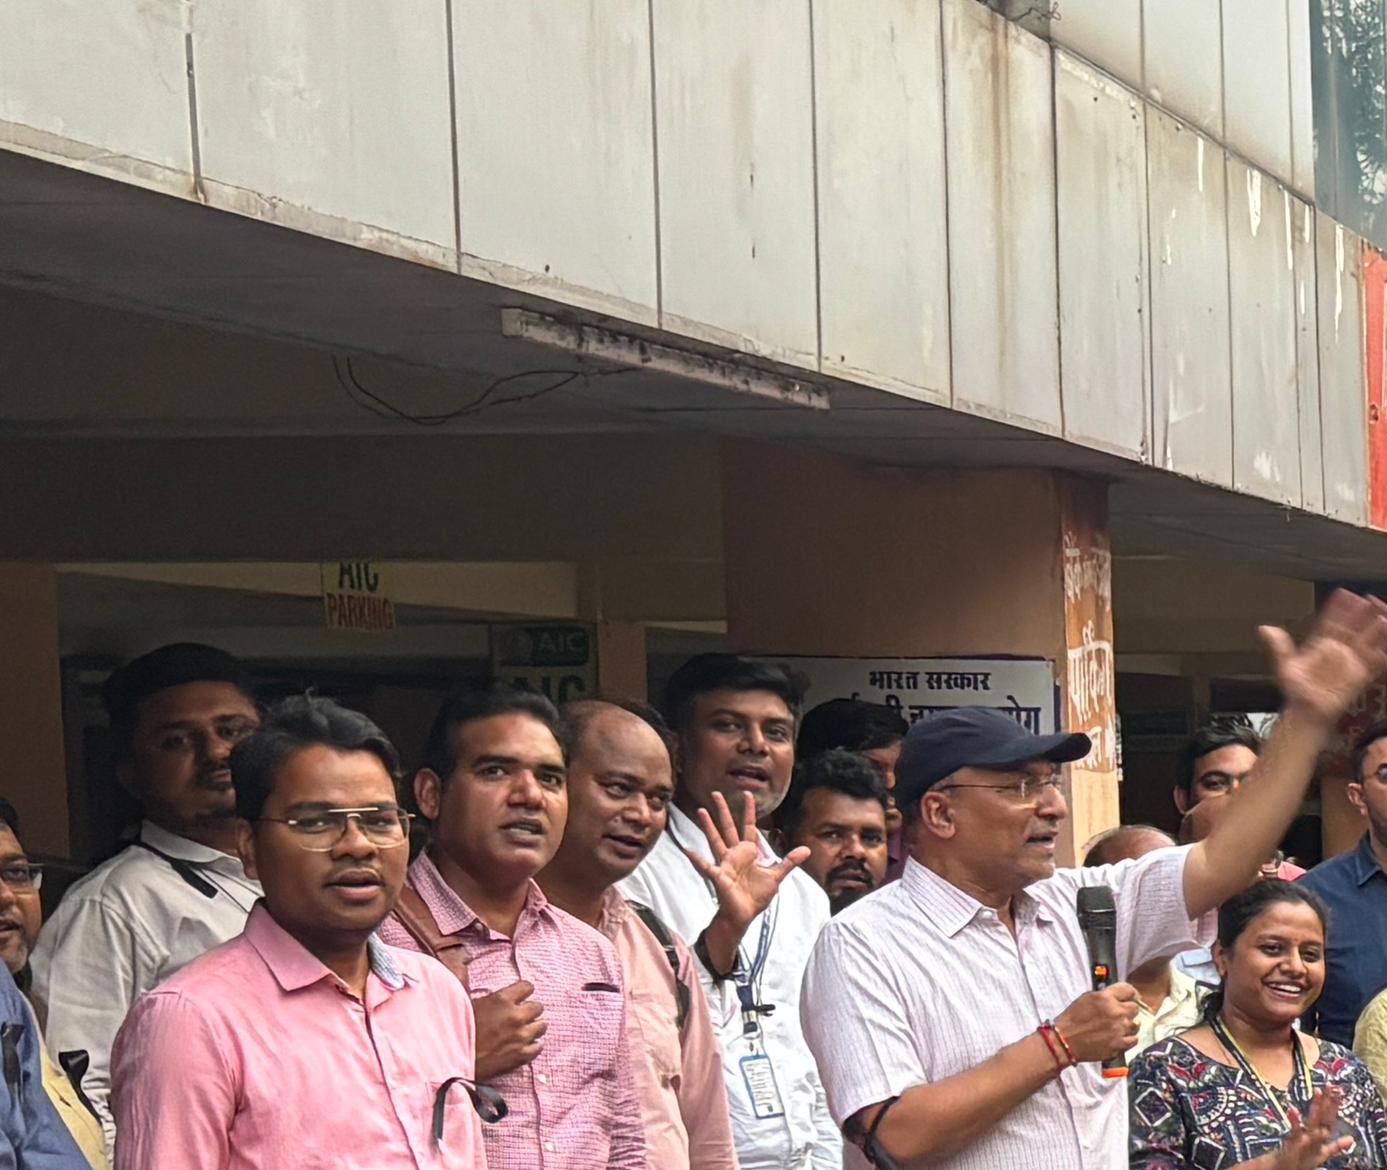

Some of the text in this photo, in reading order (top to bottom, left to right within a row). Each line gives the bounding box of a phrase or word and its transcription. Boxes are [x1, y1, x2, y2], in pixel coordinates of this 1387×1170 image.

[326, 592, 394, 630] PARKING
[869, 671, 992, 691] भारत सरकार
